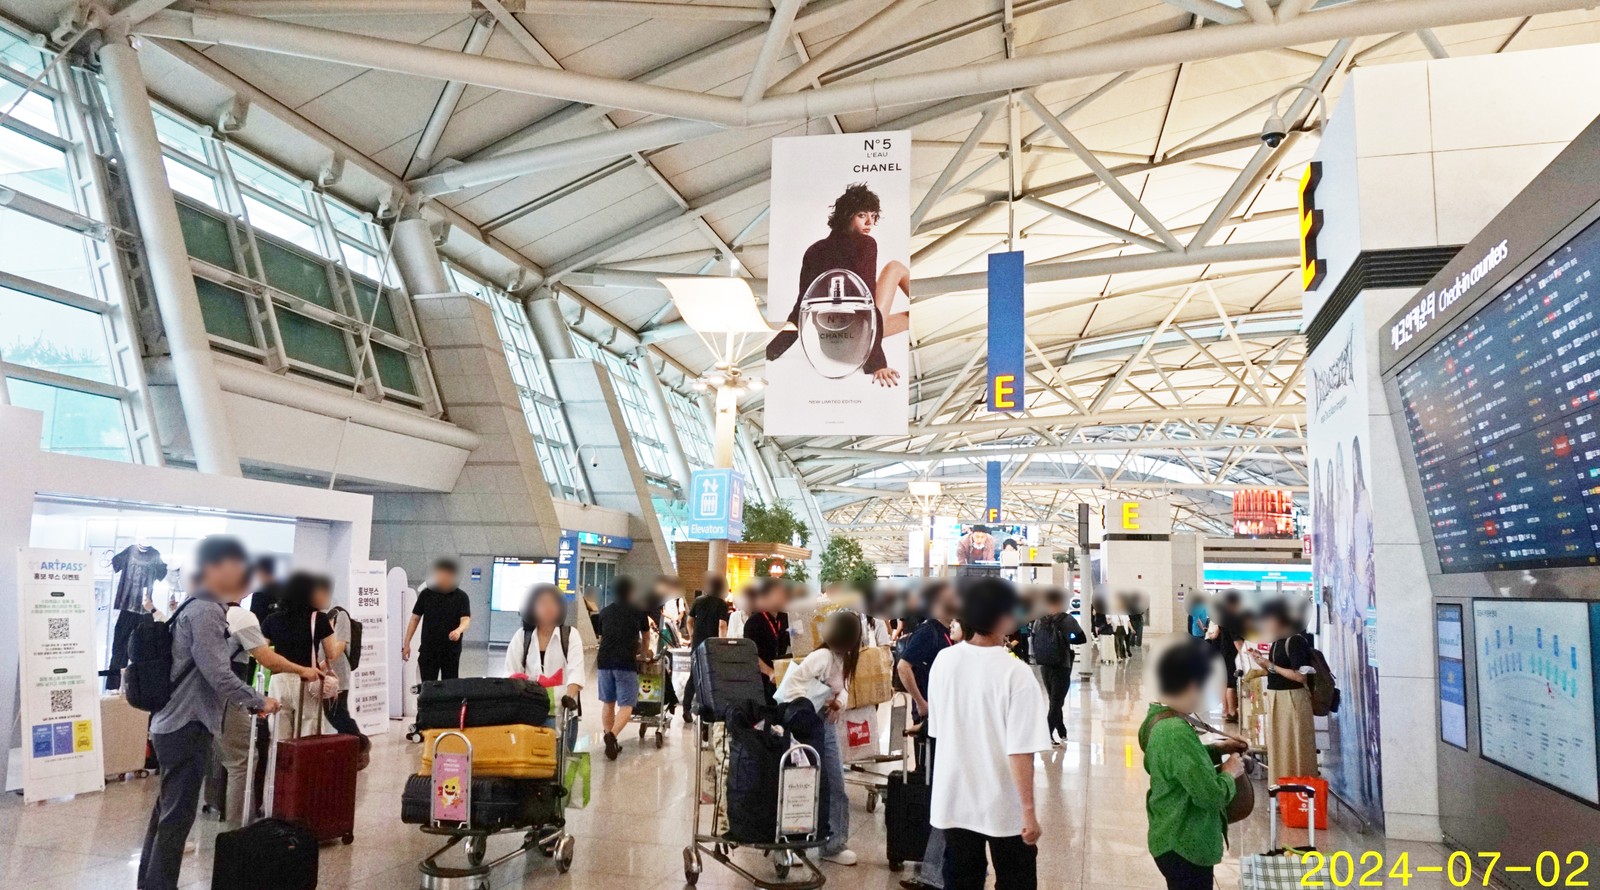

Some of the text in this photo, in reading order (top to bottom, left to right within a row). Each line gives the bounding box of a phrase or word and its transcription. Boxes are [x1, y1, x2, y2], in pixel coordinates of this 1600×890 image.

[853, 163, 902, 173] CHANEL
[1439, 239, 1508, 312] Check-in counters
[995, 375, 1015, 408] E
[988, 508, 998, 523] F
[1122, 502, 1140, 530] E
[691, 523, 724, 534] Elevators
[1029, 547, 1038, 561] F
[358, 597, 379, 607] 운영안내
